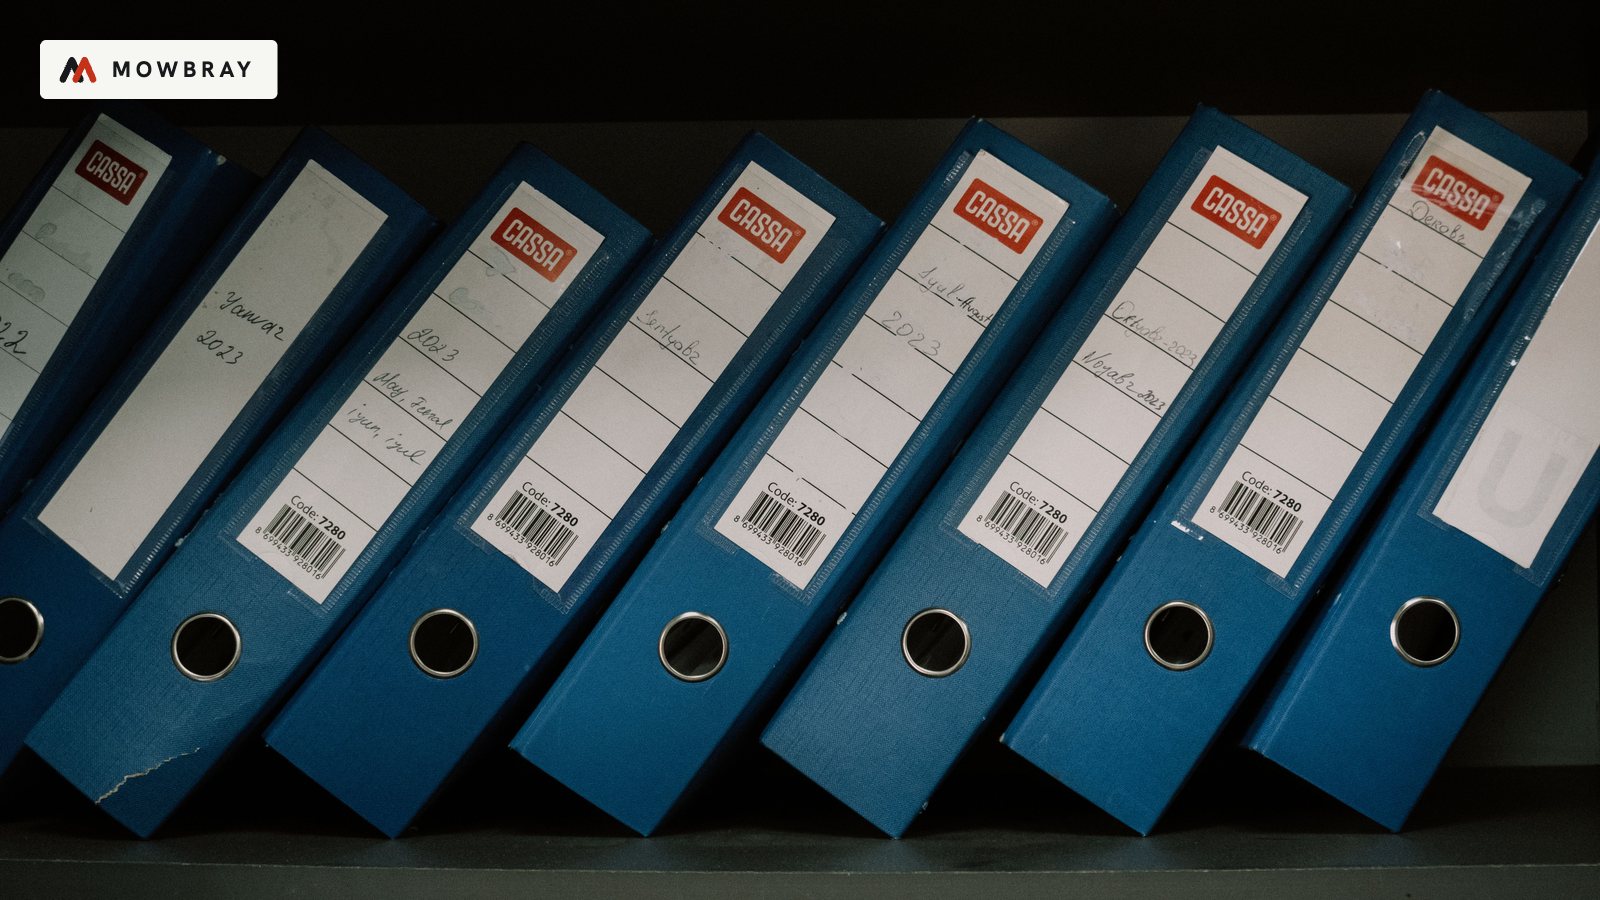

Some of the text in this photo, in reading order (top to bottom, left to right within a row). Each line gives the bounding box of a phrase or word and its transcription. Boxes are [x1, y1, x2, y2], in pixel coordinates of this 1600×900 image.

[86, 151, 136, 195] CASSA
[1423, 167, 1491, 220] CASSA
[729, 199, 793, 253] CASSA
[965, 190, 1031, 244] CASSA
[1202, 186, 1269, 239] CASSA
[502, 219, 564, 272] CASSA
[197, 330, 243, 364] 2023
[407, 328, 459, 361] 2023
[882, 311, 940, 356] 2023
[522, 481, 579, 527] Code: 7280
[767, 482, 826, 526] Code: 7280
[1010, 481, 1068, 524] Code: 7280
[1242, 471, 1302, 512] Code: 7280
[291, 495, 346, 541] Code: 7280
[487, 513, 555, 567] 8 699433 928016
[733, 515, 803, 567] 8 699433 928016
[1209, 506, 1282, 554] 8 699433 928016
[255, 526, 322, 580] 8 699433 928016
[984, 521, 1015, 544] 699433
[1017, 542, 1046, 565] 928016
